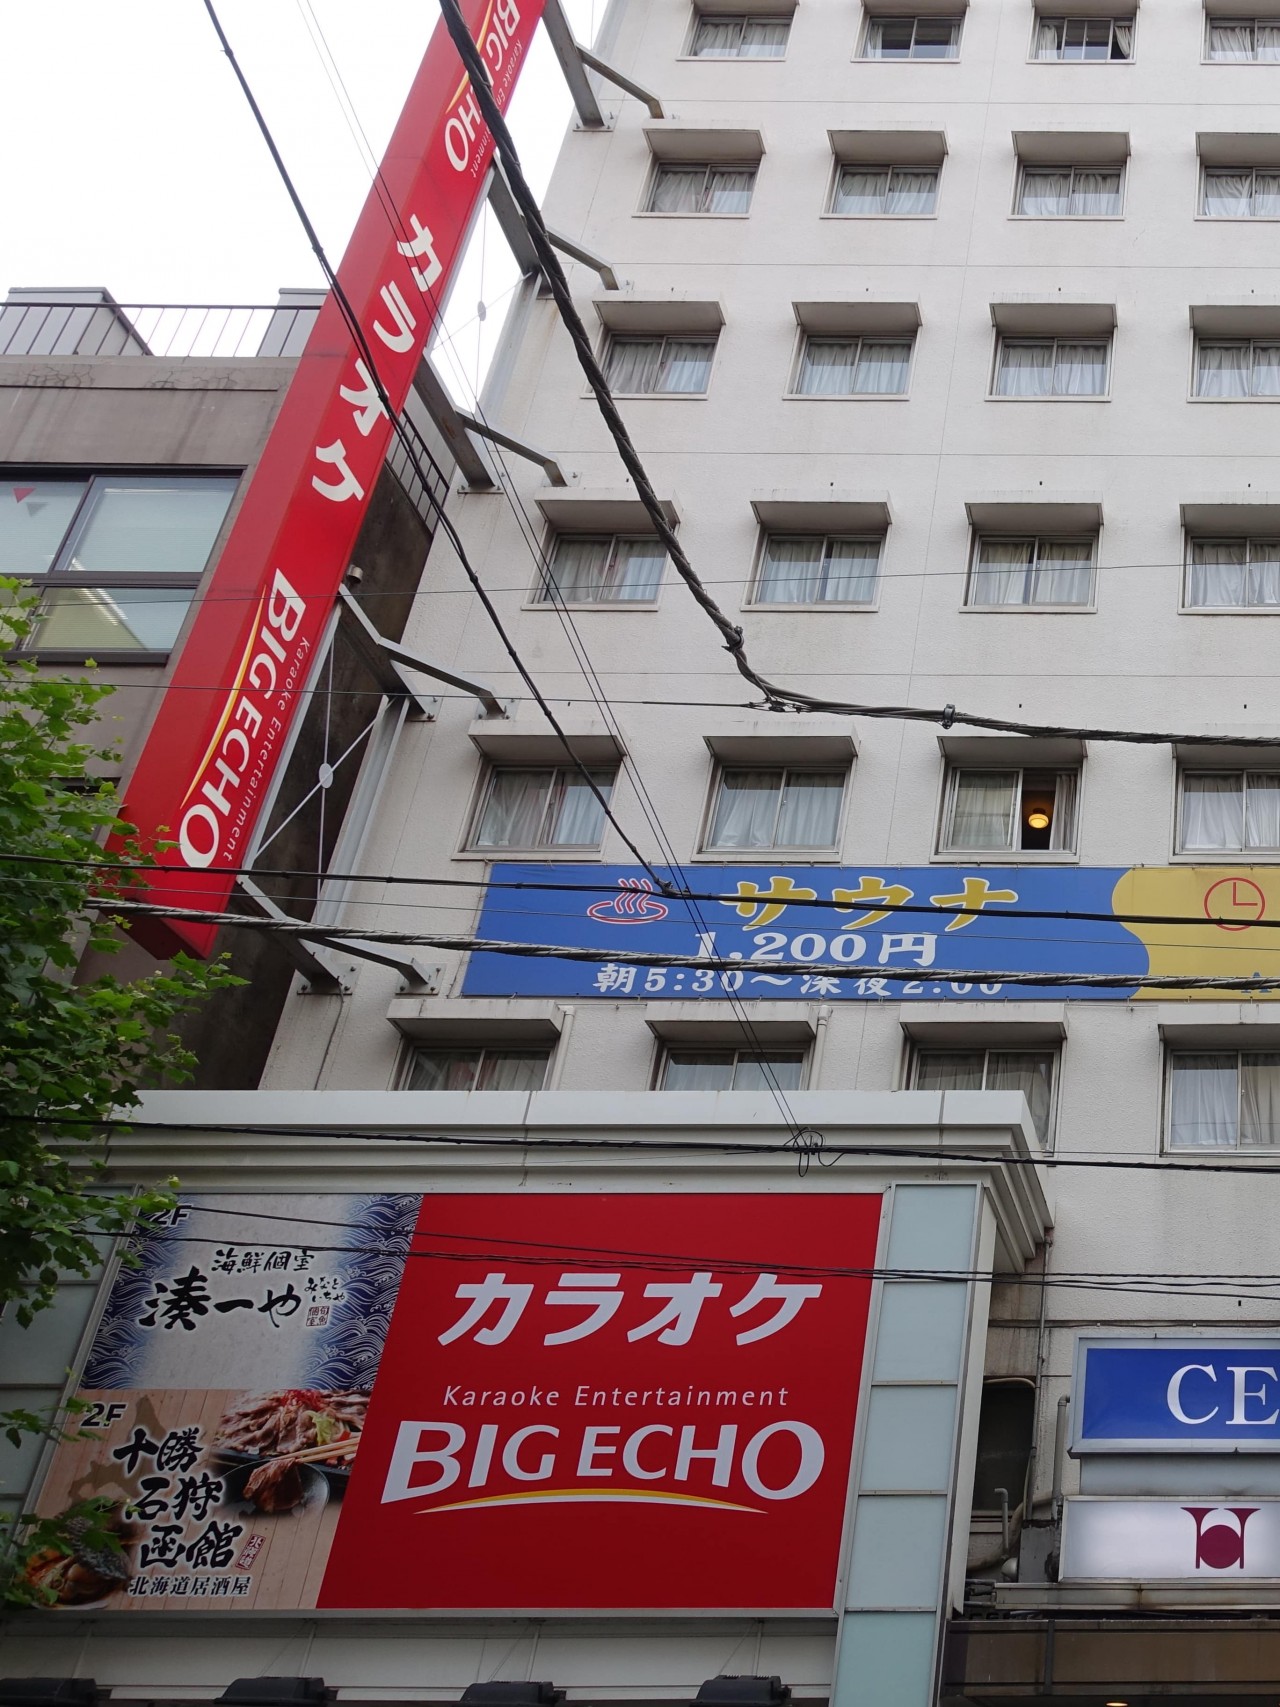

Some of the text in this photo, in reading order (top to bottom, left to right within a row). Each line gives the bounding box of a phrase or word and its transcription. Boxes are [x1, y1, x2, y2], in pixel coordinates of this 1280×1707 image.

[311, 213, 443, 502] カラオケ
[179, 568, 306, 868] BIG ECHO
[224, 637, 310, 862] Karaoke Entertainment
[718, 875, 1019, 932] サウナ
[211, 1248, 315, 1275] 海鮮個室
[437, 1272, 823, 1347] カラオケ
[81, 1403, 126, 1427] 2F
[443, 1385, 789, 1406] Karaoke Entertainment
[113, 1427, 204, 1474] 十勝
[381, 1420, 826, 1504] BIG ECHO
[130, 1576, 251, 1596] 北海道居酒屋
